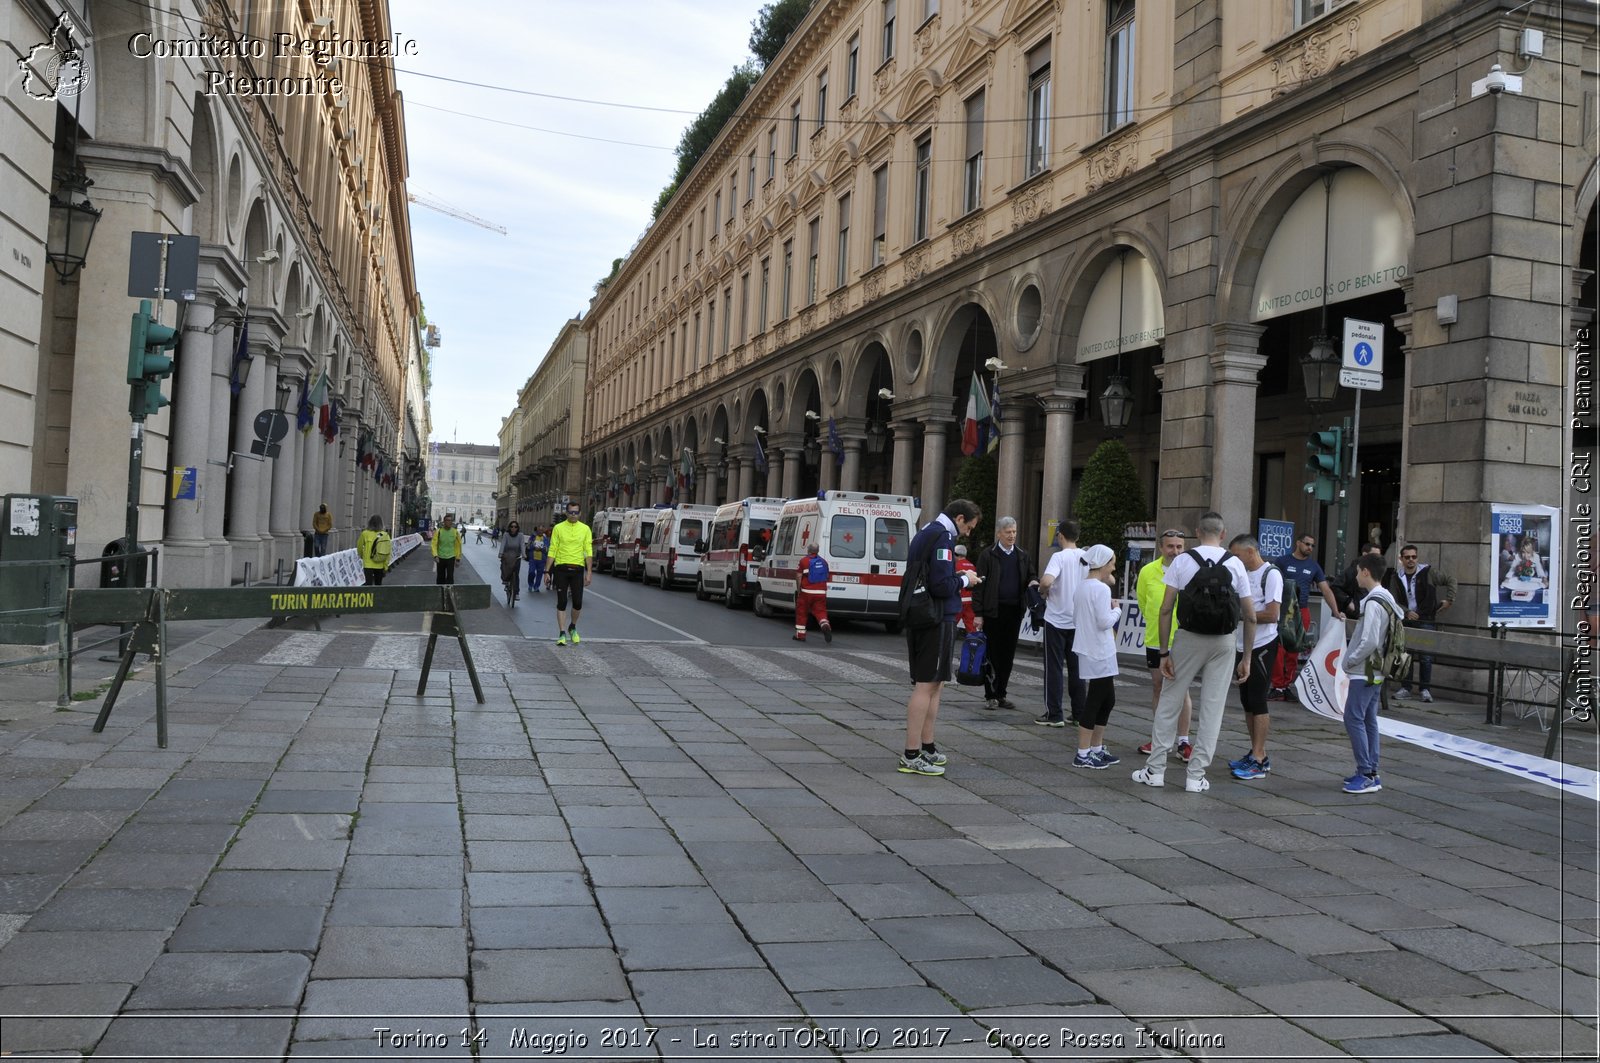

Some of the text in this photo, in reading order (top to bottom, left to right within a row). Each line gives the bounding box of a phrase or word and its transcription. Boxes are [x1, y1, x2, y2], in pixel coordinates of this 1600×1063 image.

[1258, 294, 1291, 313] UNITED
[1295, 284, 1334, 303] COLORS
[1337, 280, 1351, 293] OF
[1351, 332, 1376, 340] pedonale
[1081, 343, 1102, 355] UNITED
[1129, 334, 1138, 344] OF
[1515, 391, 1540, 402] PIAZZA
[1508, 404, 1548, 416] SAN CARLO
[1499, 518, 1522, 526] GESTO
[1266, 525, 1293, 536] PICCOLO
[1260, 533, 1292, 549] GESTO
[1266, 547, 1286, 557] PESO
[271, 593, 374, 610] TURIN MARATHON
[1304, 663, 1323, 704] ovacoop
